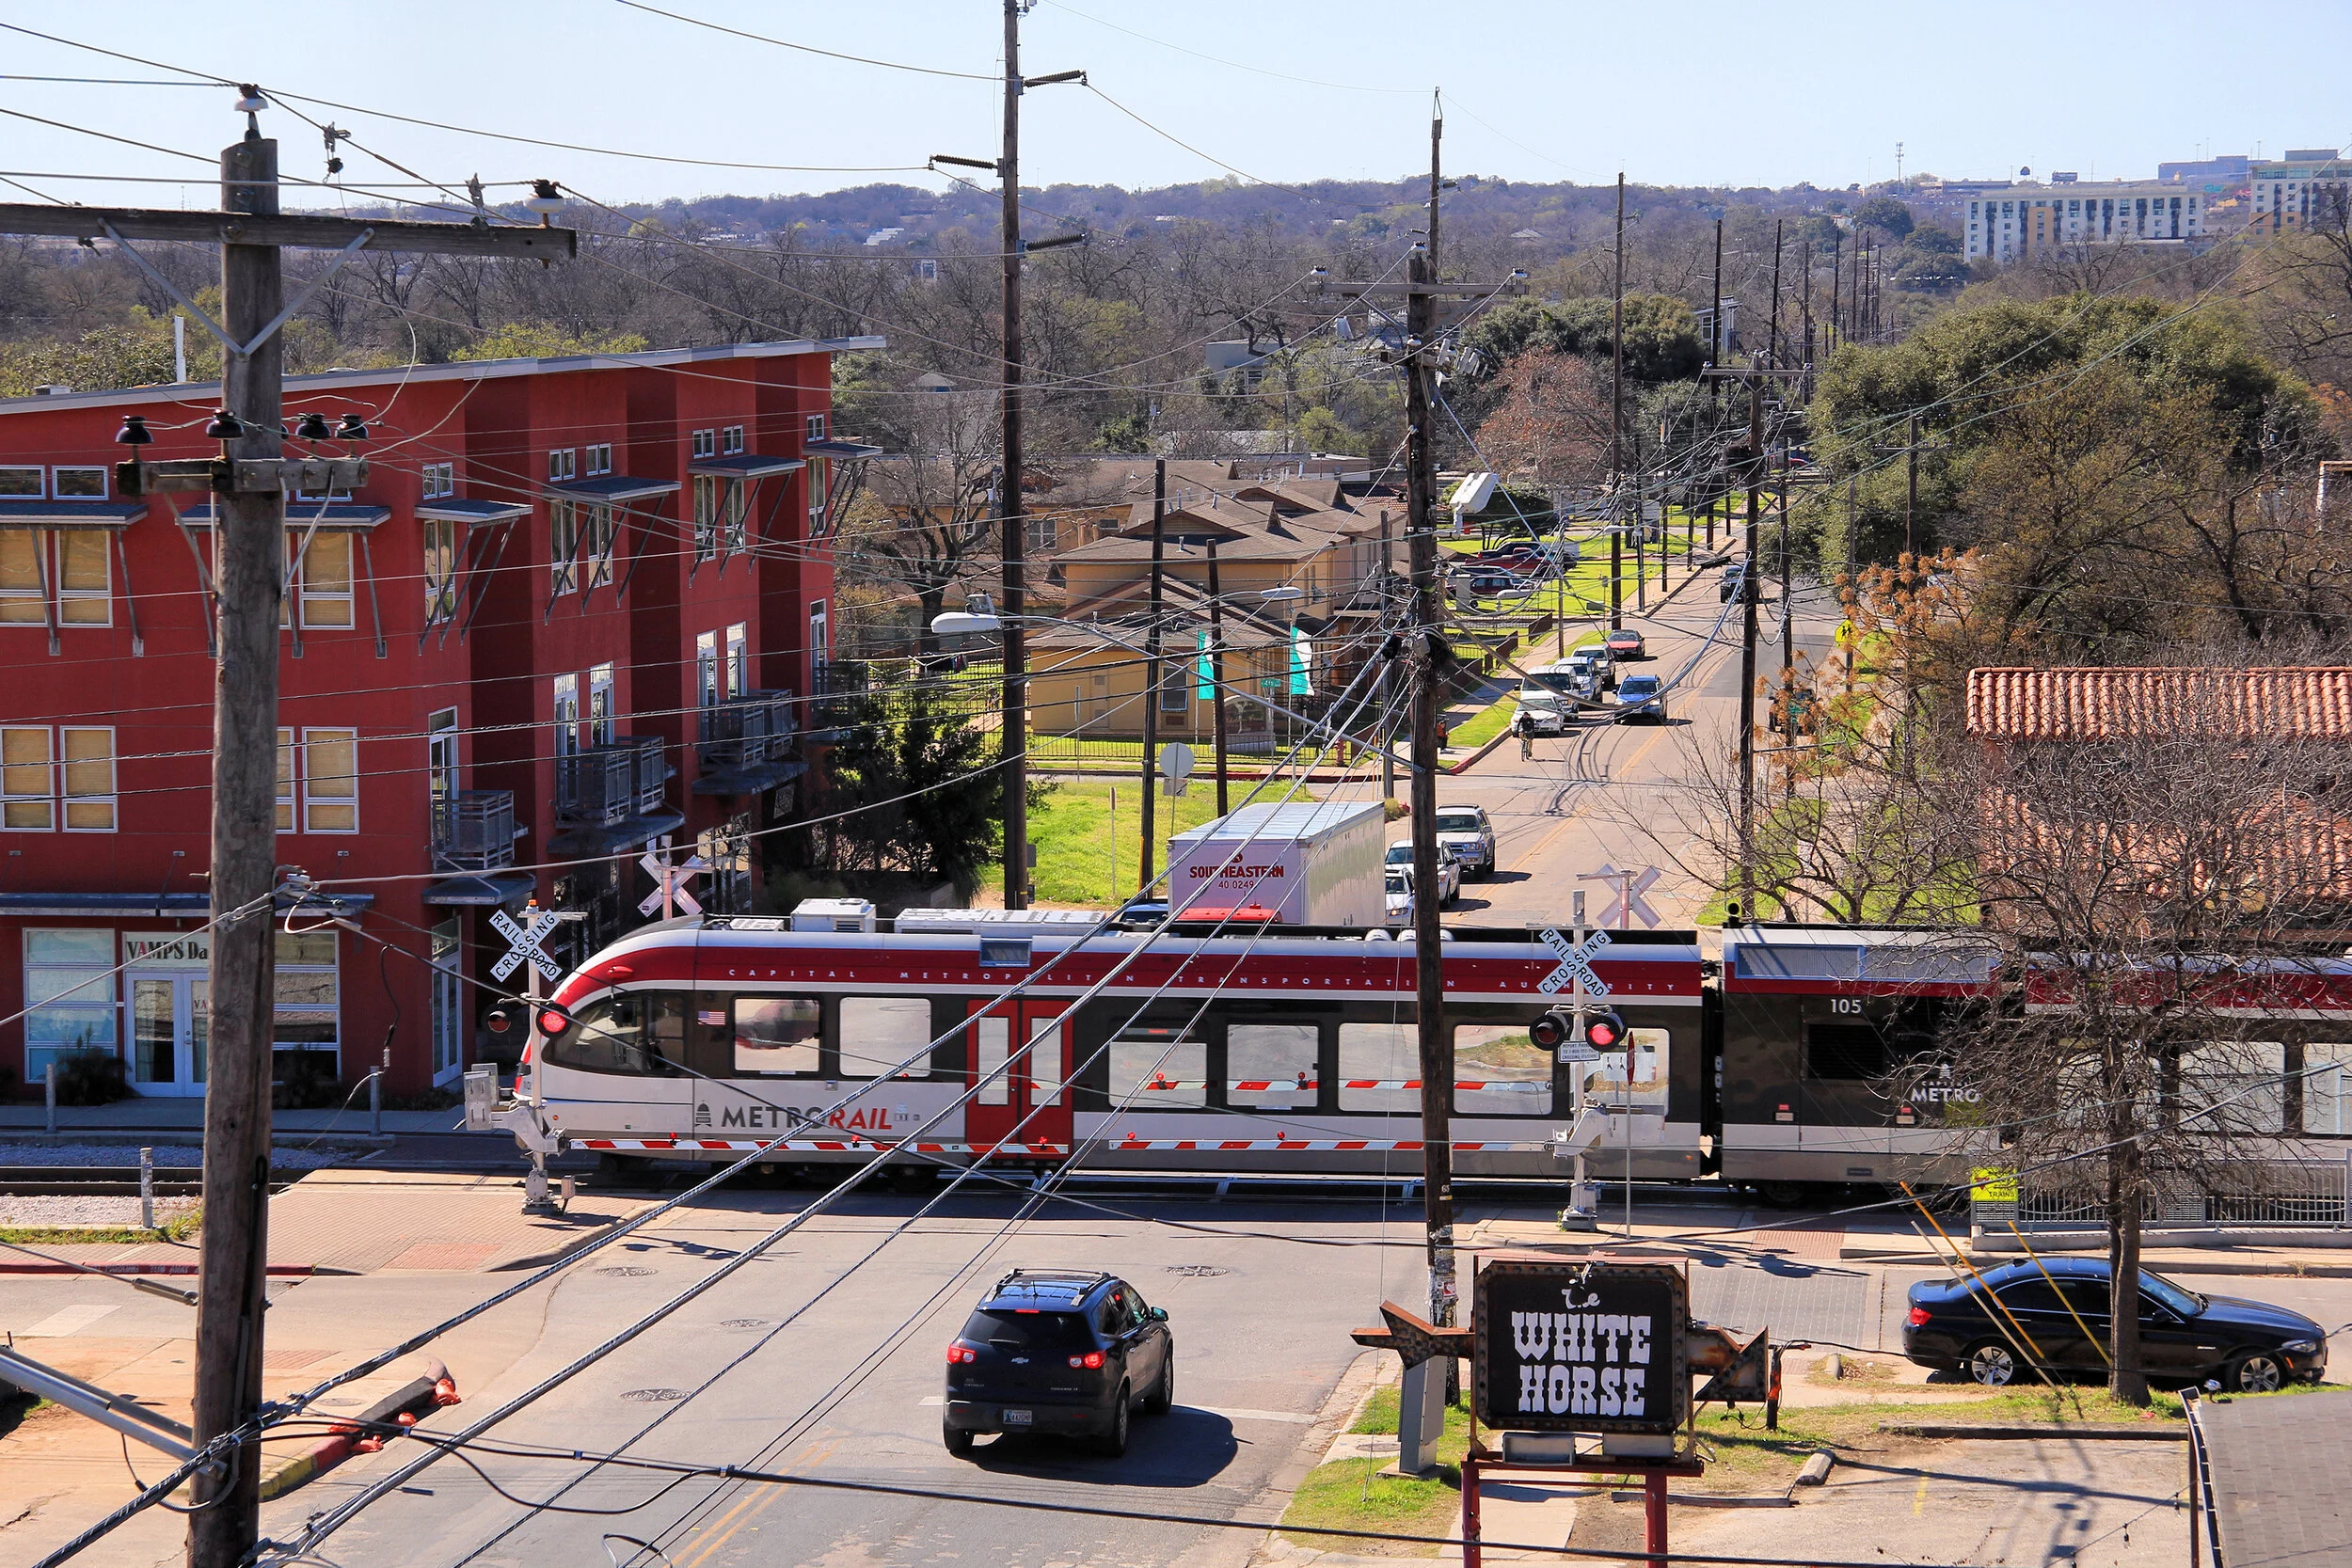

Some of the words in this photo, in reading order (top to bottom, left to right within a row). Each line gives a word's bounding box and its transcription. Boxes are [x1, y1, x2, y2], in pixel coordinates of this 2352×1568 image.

[1218, 880, 1230, 889] 40
[1232, 880, 1255, 889] 0249
[126, 941, 184, 960] VAMPS
[492, 913, 520, 943] RAIL
[528, 947, 558, 976] ROAD
[495, 913, 555, 977] CROSSING
[1541, 933, 1607, 994] CROSSING
[1542, 928, 1569, 961] RAIL
[1576, 966, 1605, 997] ROAD
[728, 968, 855, 978] CAPITAL
[899, 971, 1135, 983] METROPLITN
[1178, 975, 1455, 988] TRANSPORTATIN
[1499, 981, 1675, 991] AUHRITY
[1830, 998, 1862, 1014] 105
[1910, 1087, 1981, 1103] METRO
[722, 1105, 893, 1130] METRORAIL
[1561, 1288, 1600, 1309] Te
[1511, 1310, 1652, 1365] WHITE
[1518, 1364, 1645, 1417] HORSE
